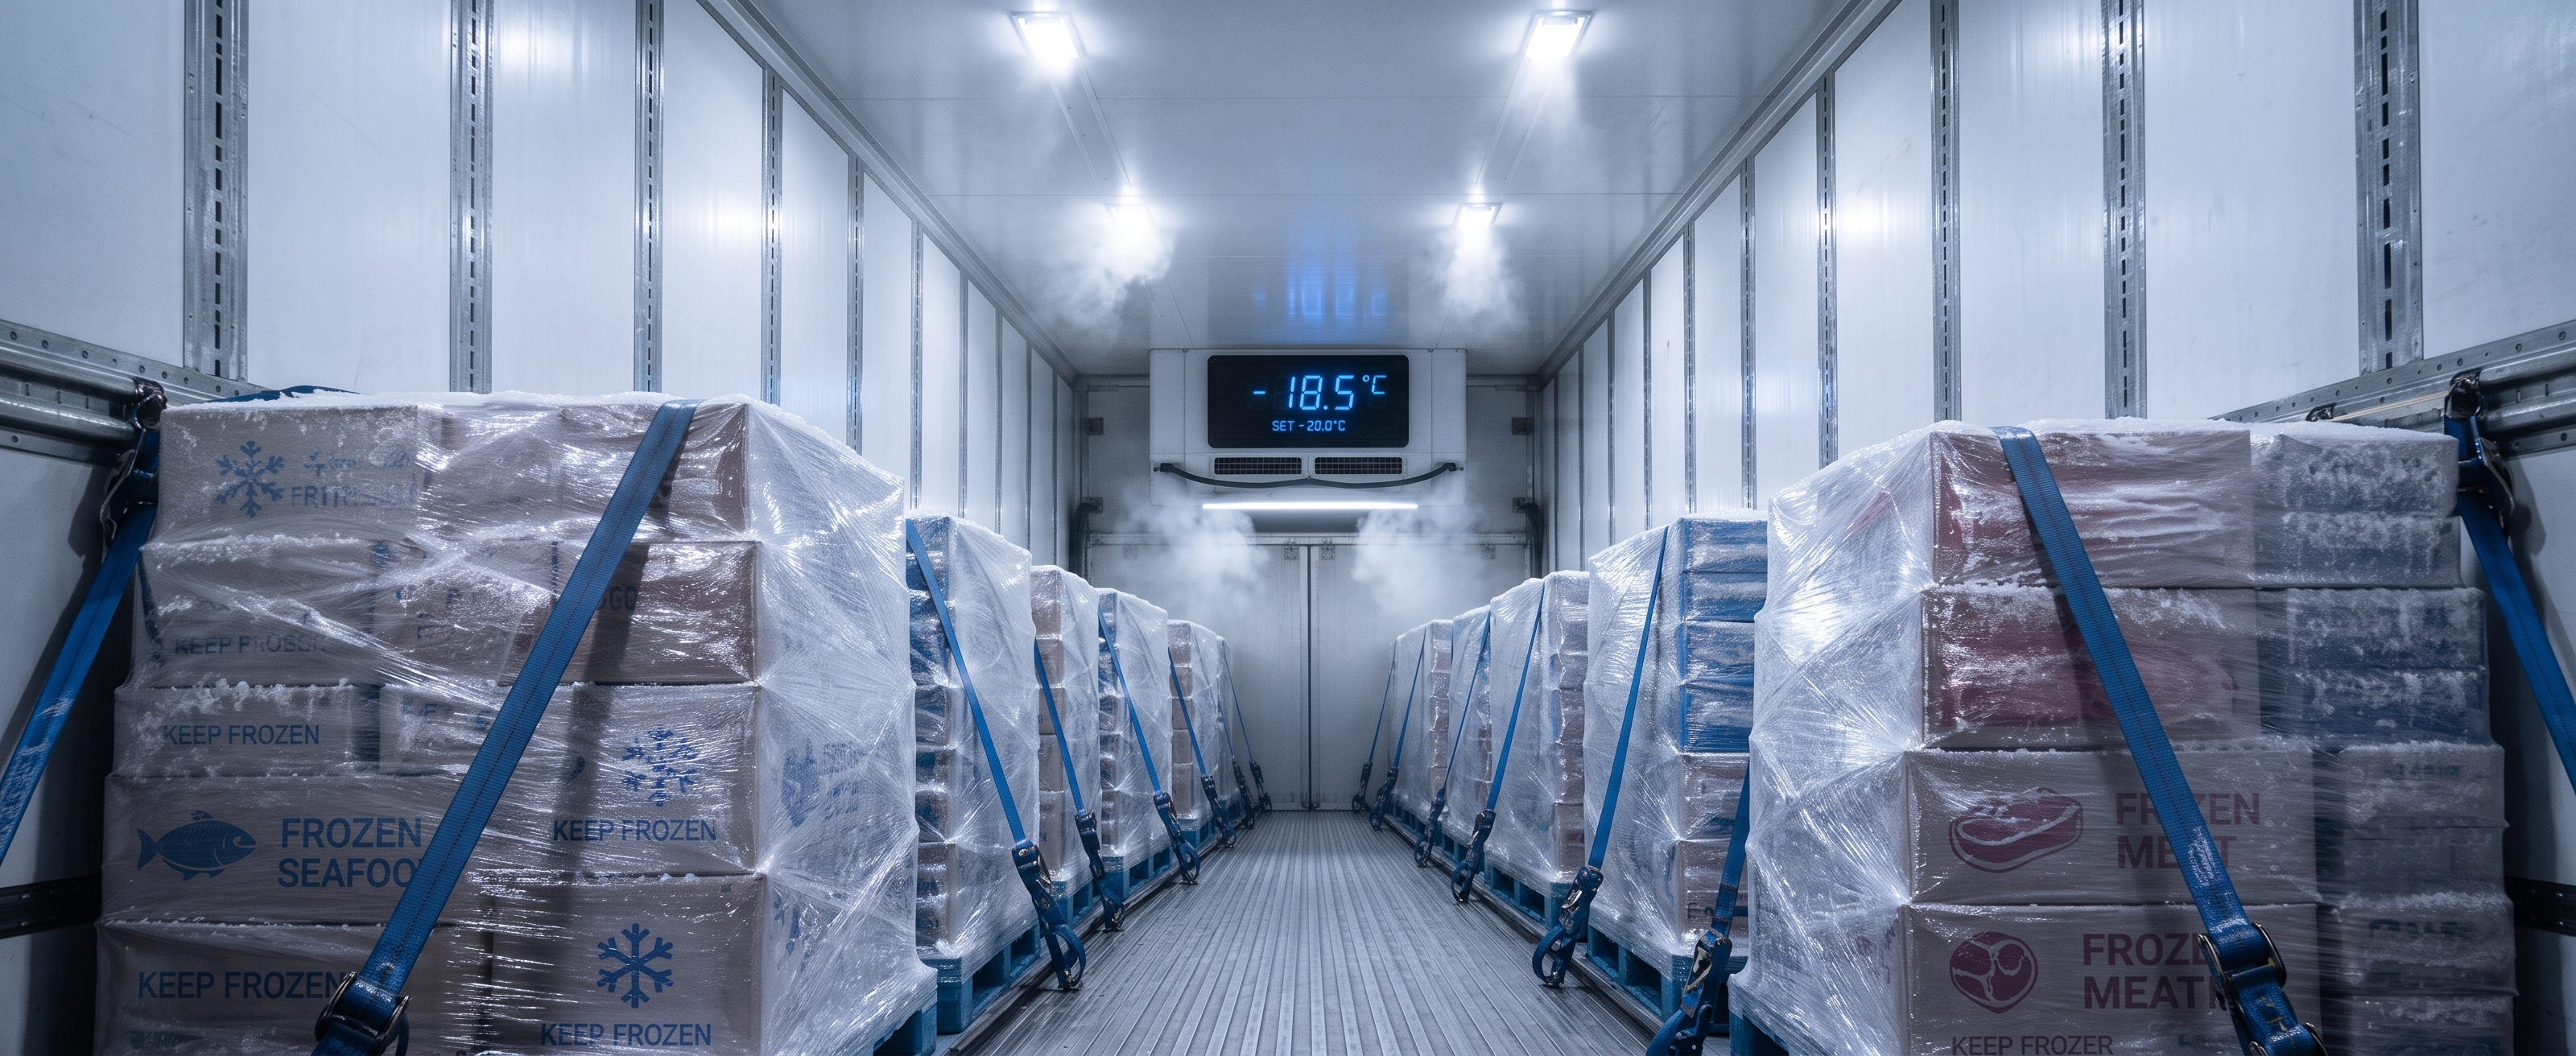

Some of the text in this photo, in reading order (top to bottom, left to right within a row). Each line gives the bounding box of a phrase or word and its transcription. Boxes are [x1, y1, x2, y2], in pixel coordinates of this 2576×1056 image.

[1272, 420, 1295, 431] SET
[174, 636, 232, 654] KEEP
[163, 724, 320, 745] KEEP FROZEN
[282, 818, 422, 848] FROZEN
[553, 819, 717, 842] KEEP FROZEN
[277, 857, 423, 888] SEAFOO
[138, 971, 346, 999] KEEP FROZEN
[541, 1023, 712, 1046] KEEP FROZEN
[1951, 1035, 2114, 1056] KEEP FROZER
